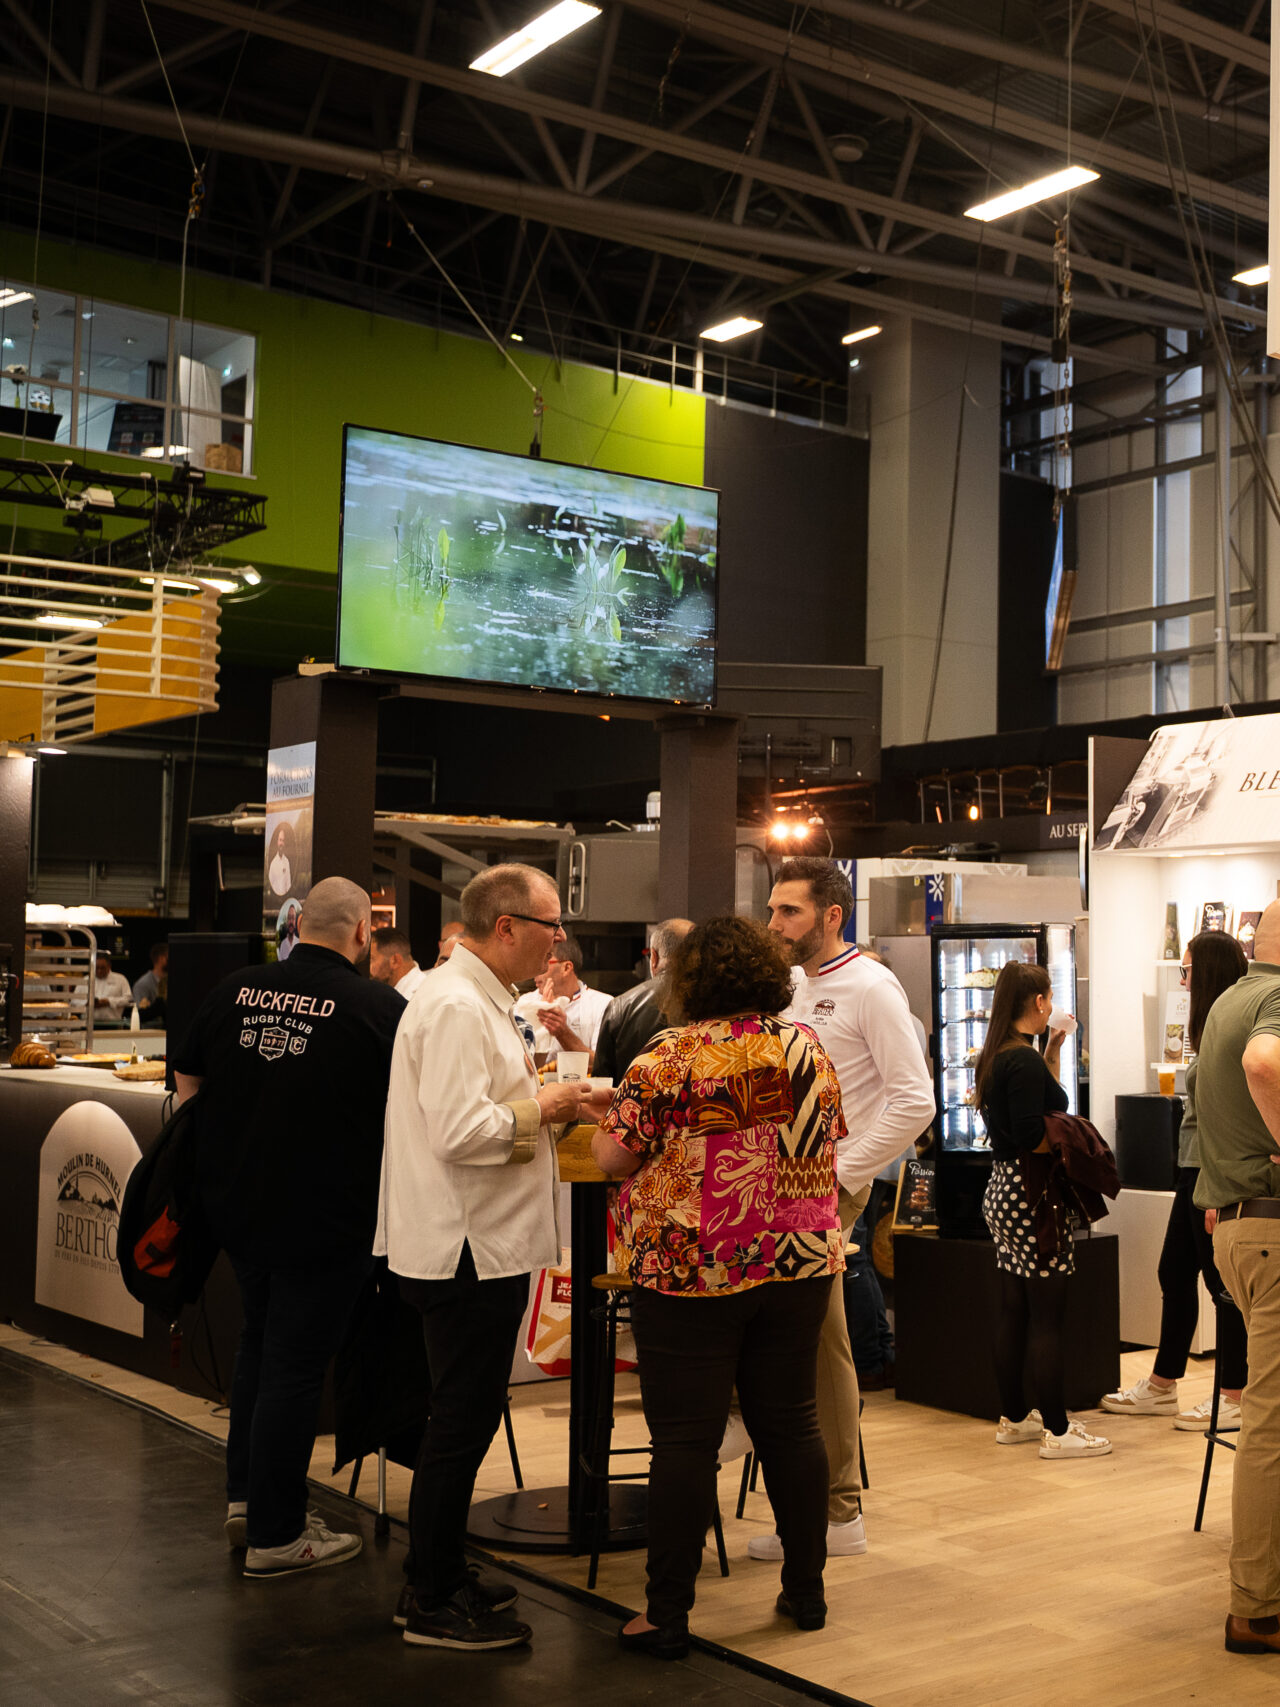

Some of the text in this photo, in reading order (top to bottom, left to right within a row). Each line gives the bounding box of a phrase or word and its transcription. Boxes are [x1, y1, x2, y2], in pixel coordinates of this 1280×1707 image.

[1050, 824, 1065, 838] AU
[235, 987, 336, 1017] RUCKFIELD
[243, 1015, 313, 1035] RUGBY CLUB
[57, 1153, 121, 1202] MOULIN DE HURNEL
[56, 1212, 119, 1262] BERTHO
